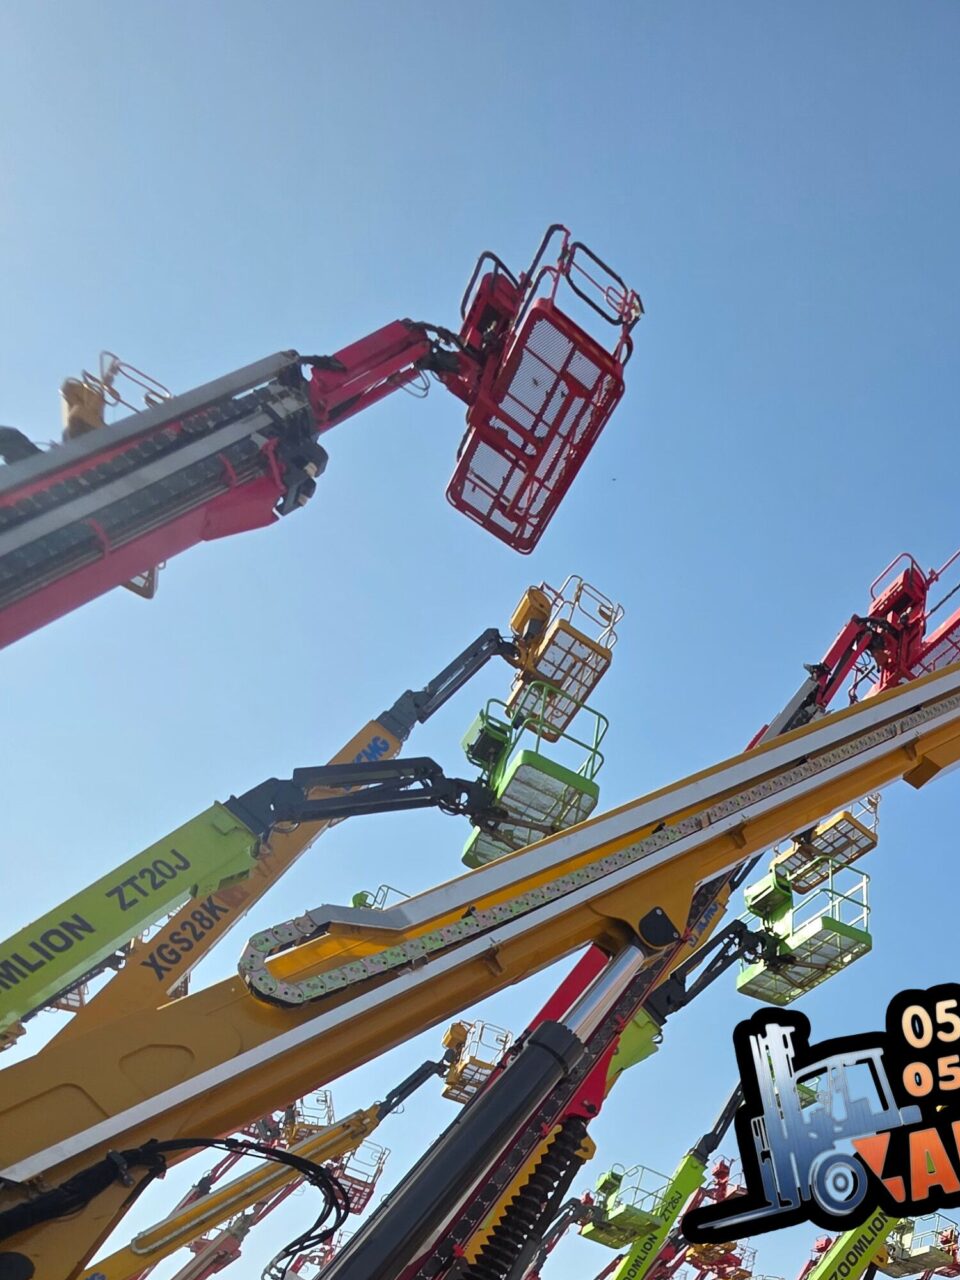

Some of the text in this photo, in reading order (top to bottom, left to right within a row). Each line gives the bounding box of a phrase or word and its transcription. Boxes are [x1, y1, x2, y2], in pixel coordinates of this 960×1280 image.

[0, 848, 191, 993] MLION ZT20J
[141, 895, 229, 981] XGS28K
[661, 1190, 683, 1222] ZT26J
